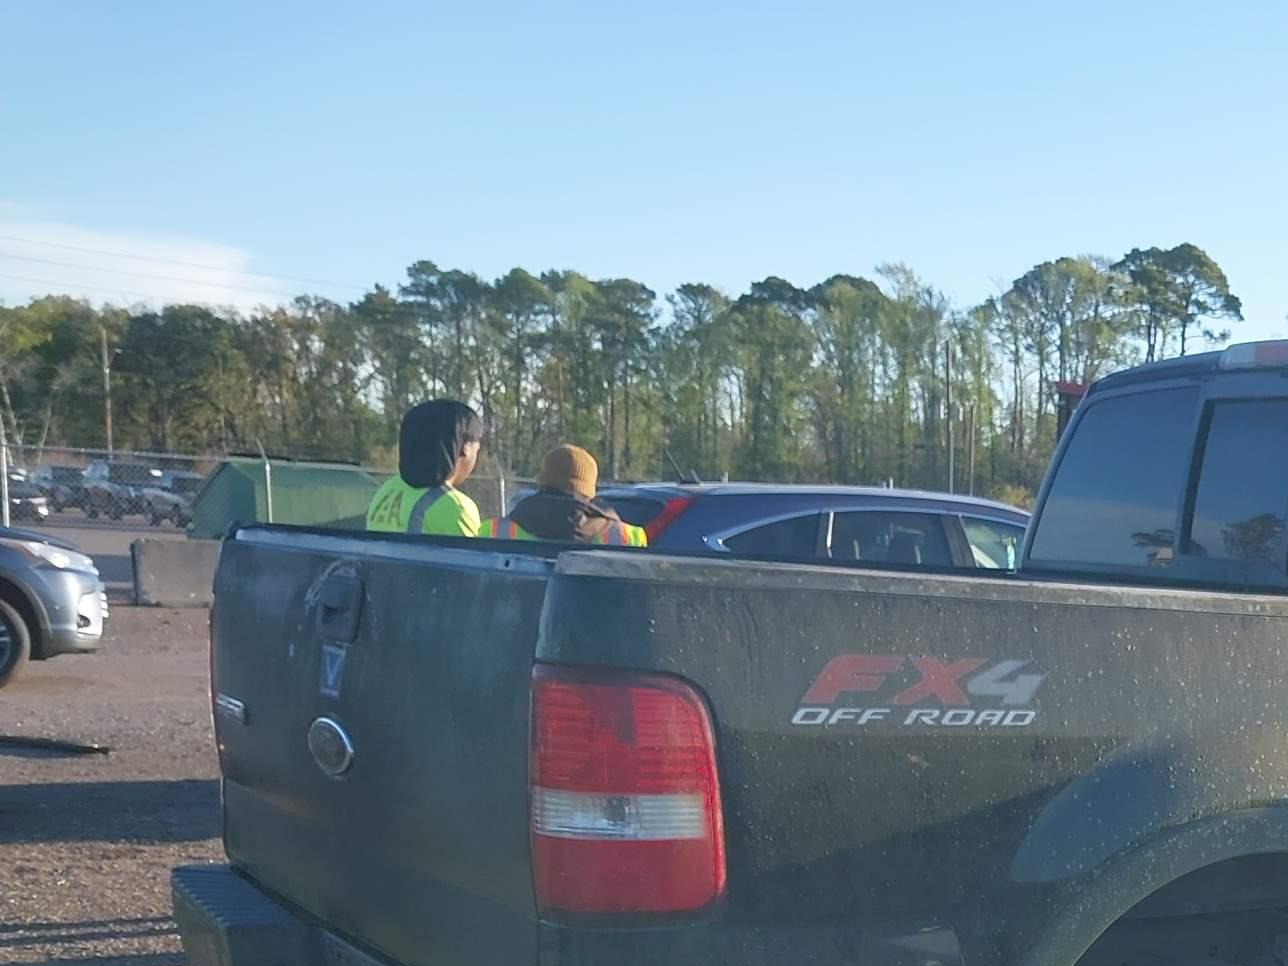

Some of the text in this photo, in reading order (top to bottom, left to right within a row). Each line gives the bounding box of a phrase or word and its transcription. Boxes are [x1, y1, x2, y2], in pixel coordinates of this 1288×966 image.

[801, 654, 1046, 705] FX4
[791, 707, 1037, 726] OFF ROAD
